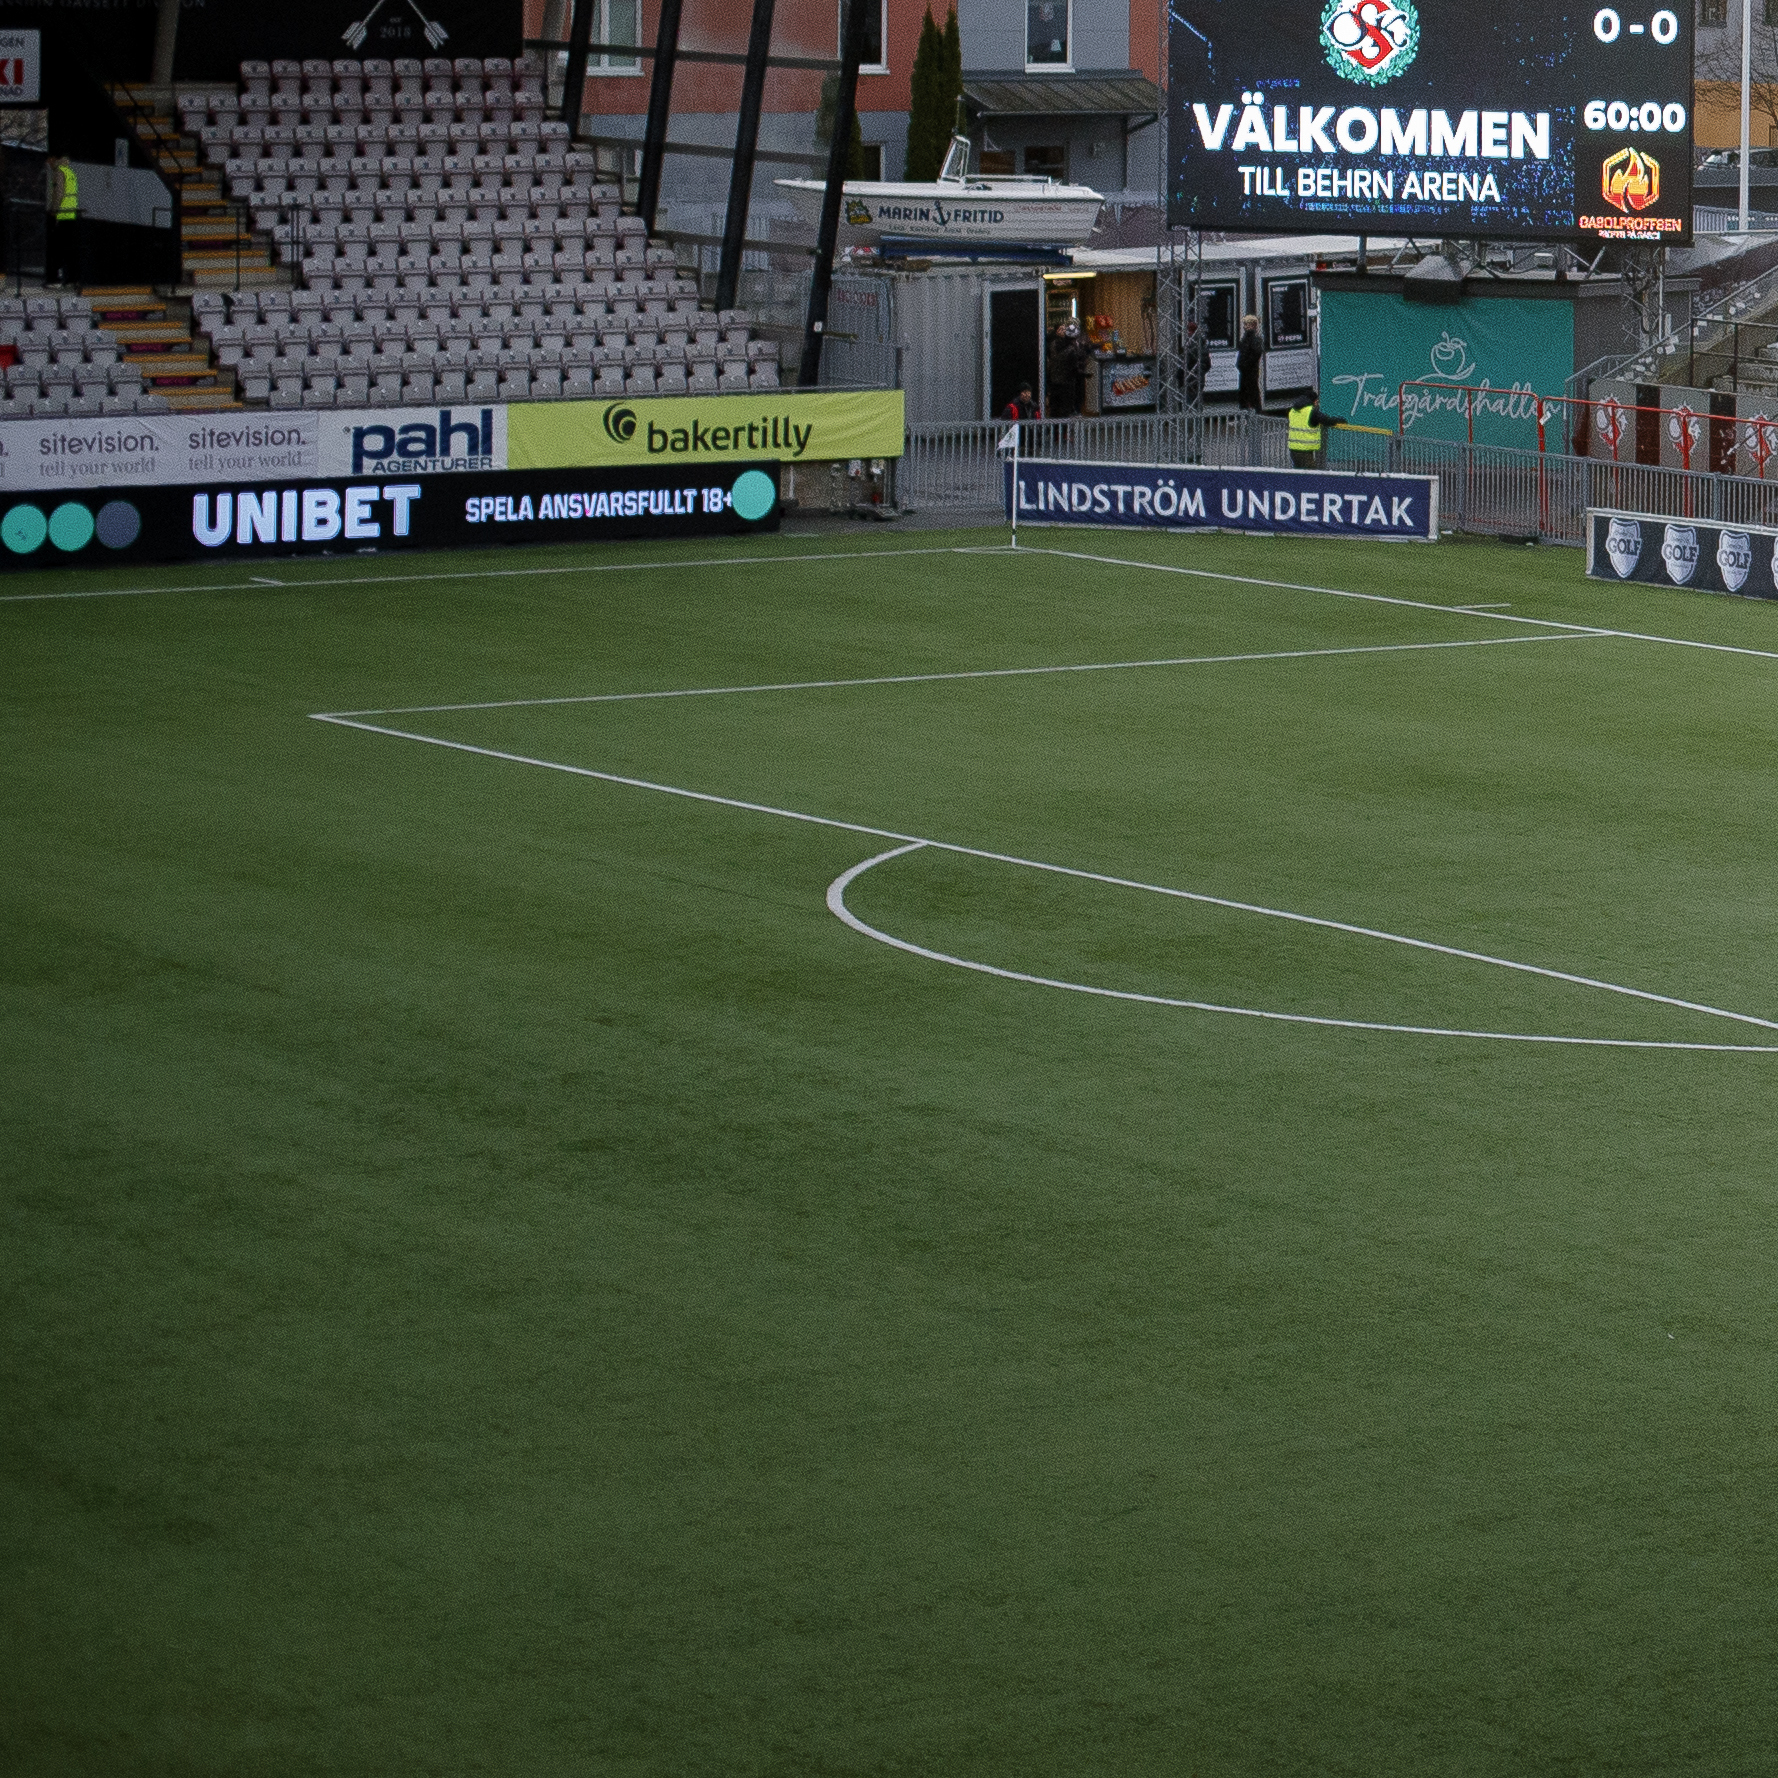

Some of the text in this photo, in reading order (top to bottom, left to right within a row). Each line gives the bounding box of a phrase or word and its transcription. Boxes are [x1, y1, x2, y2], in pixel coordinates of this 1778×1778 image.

[1593, 8, 1621, 44] 0
[1651, 9, 1678, 45] 0
[1192, 90, 1551, 160] VÄLKOMMEN
[1584, 100, 1686, 133] 60:00
[1238, 166, 1501, 203] TILL BEHRN ARENA
[878, 205, 930, 222] MARIN
[953, 209, 1004, 223] FRITID
[40, 431, 160, 456] sitevision.
[189, 425, 307, 450] sitevision.
[350, 408, 494, 475] pahl
[647, 416, 813, 458] bakertilly
[40, 458, 156, 479] tell your world
[189, 455, 215, 472] tell
[261, 451, 302, 468] world
[372, 455, 493, 474] AGENTURER
[191, 484, 421, 548] UNIBET
[465, 487, 733, 524] SPELA ANSVARSFULLT 18+
[1018, 478, 1414, 528] LINDSTRÖM UNDERTAK
[1607, 538, 1642, 556] GOLF
[1663, 543, 1699, 564] GOLF
[1718, 549, 1751, 570] GOLF
